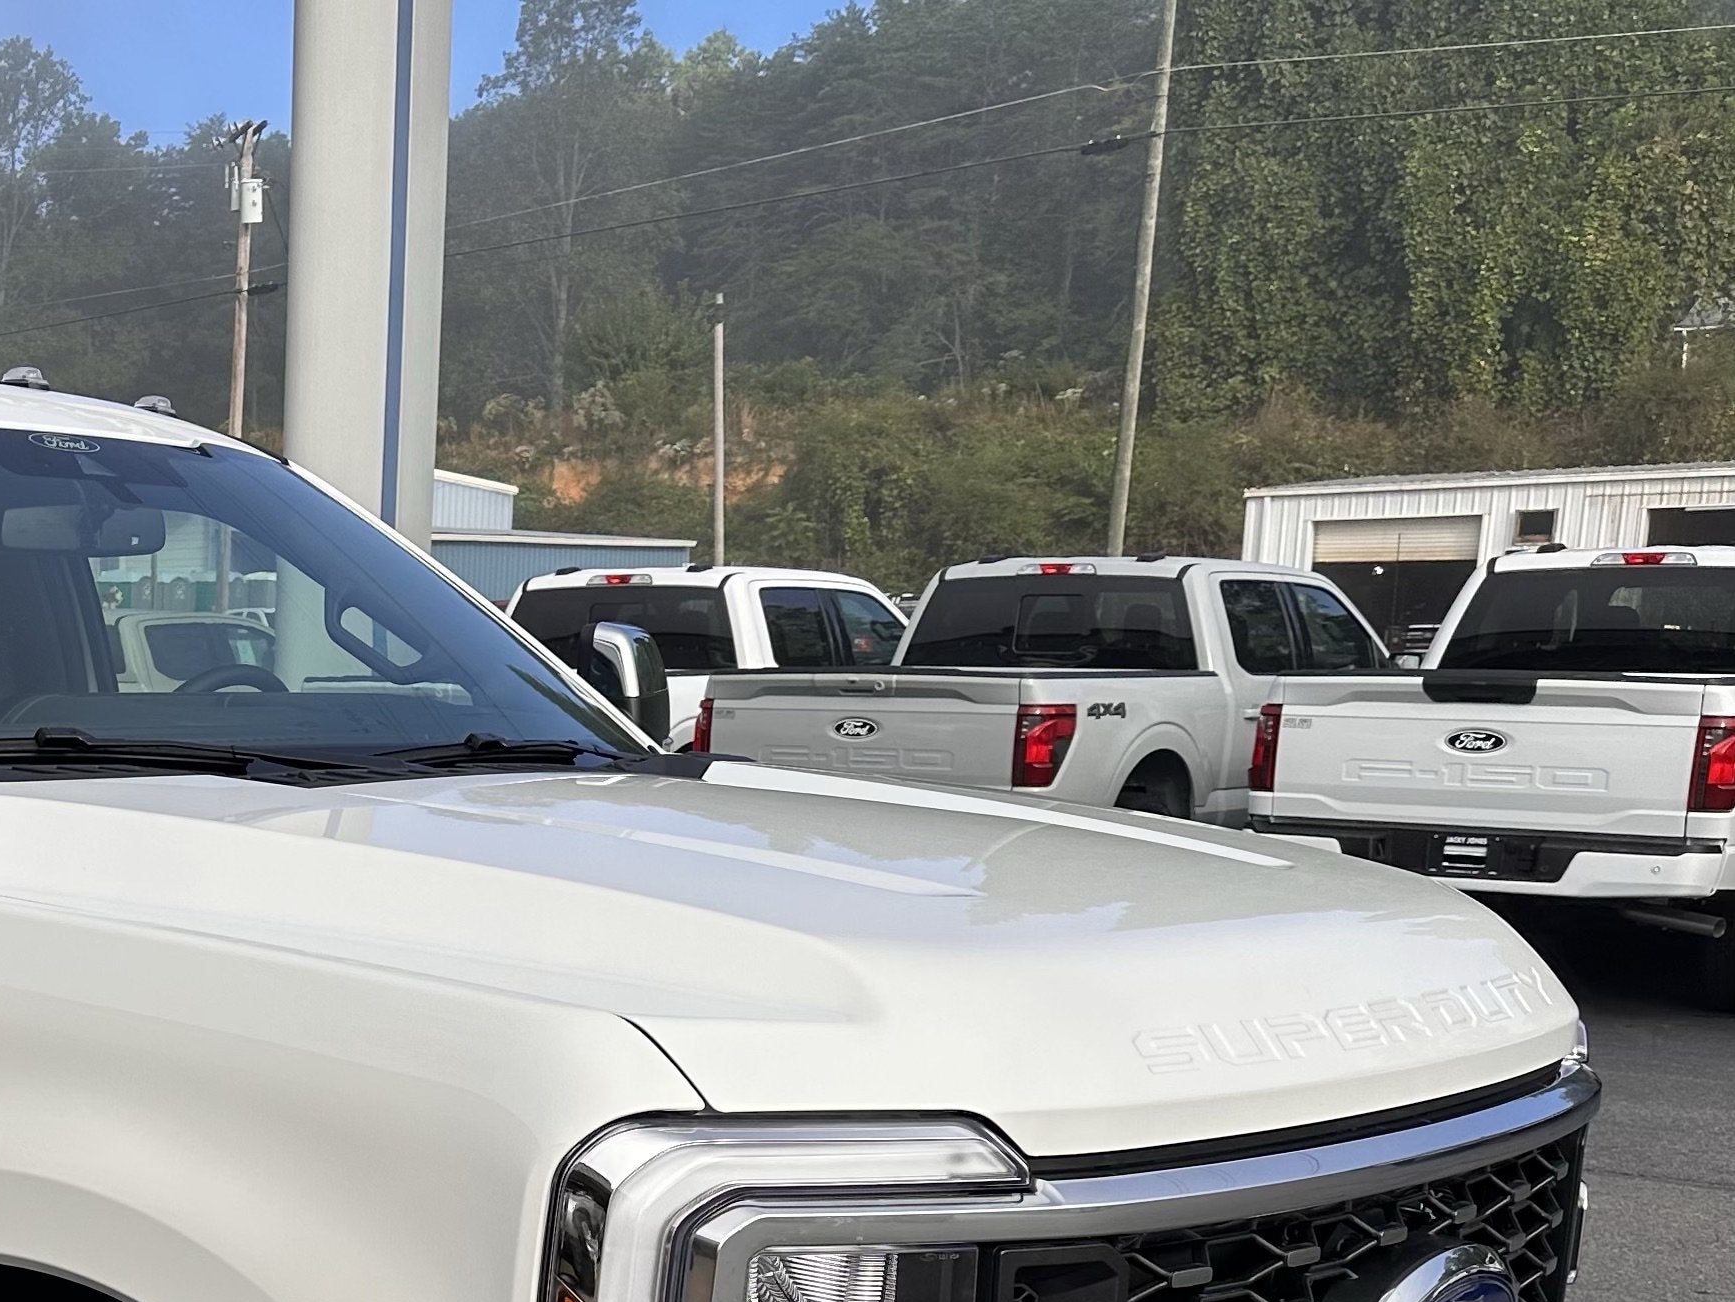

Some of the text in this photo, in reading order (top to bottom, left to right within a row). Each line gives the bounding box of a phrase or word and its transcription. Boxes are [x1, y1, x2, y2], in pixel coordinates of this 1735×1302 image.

[840, 720, 871, 735] Ford
[1455, 732, 1496, 750] Ford
[758, 744, 955, 771] F-150
[1342, 758, 1610, 793] F-150
